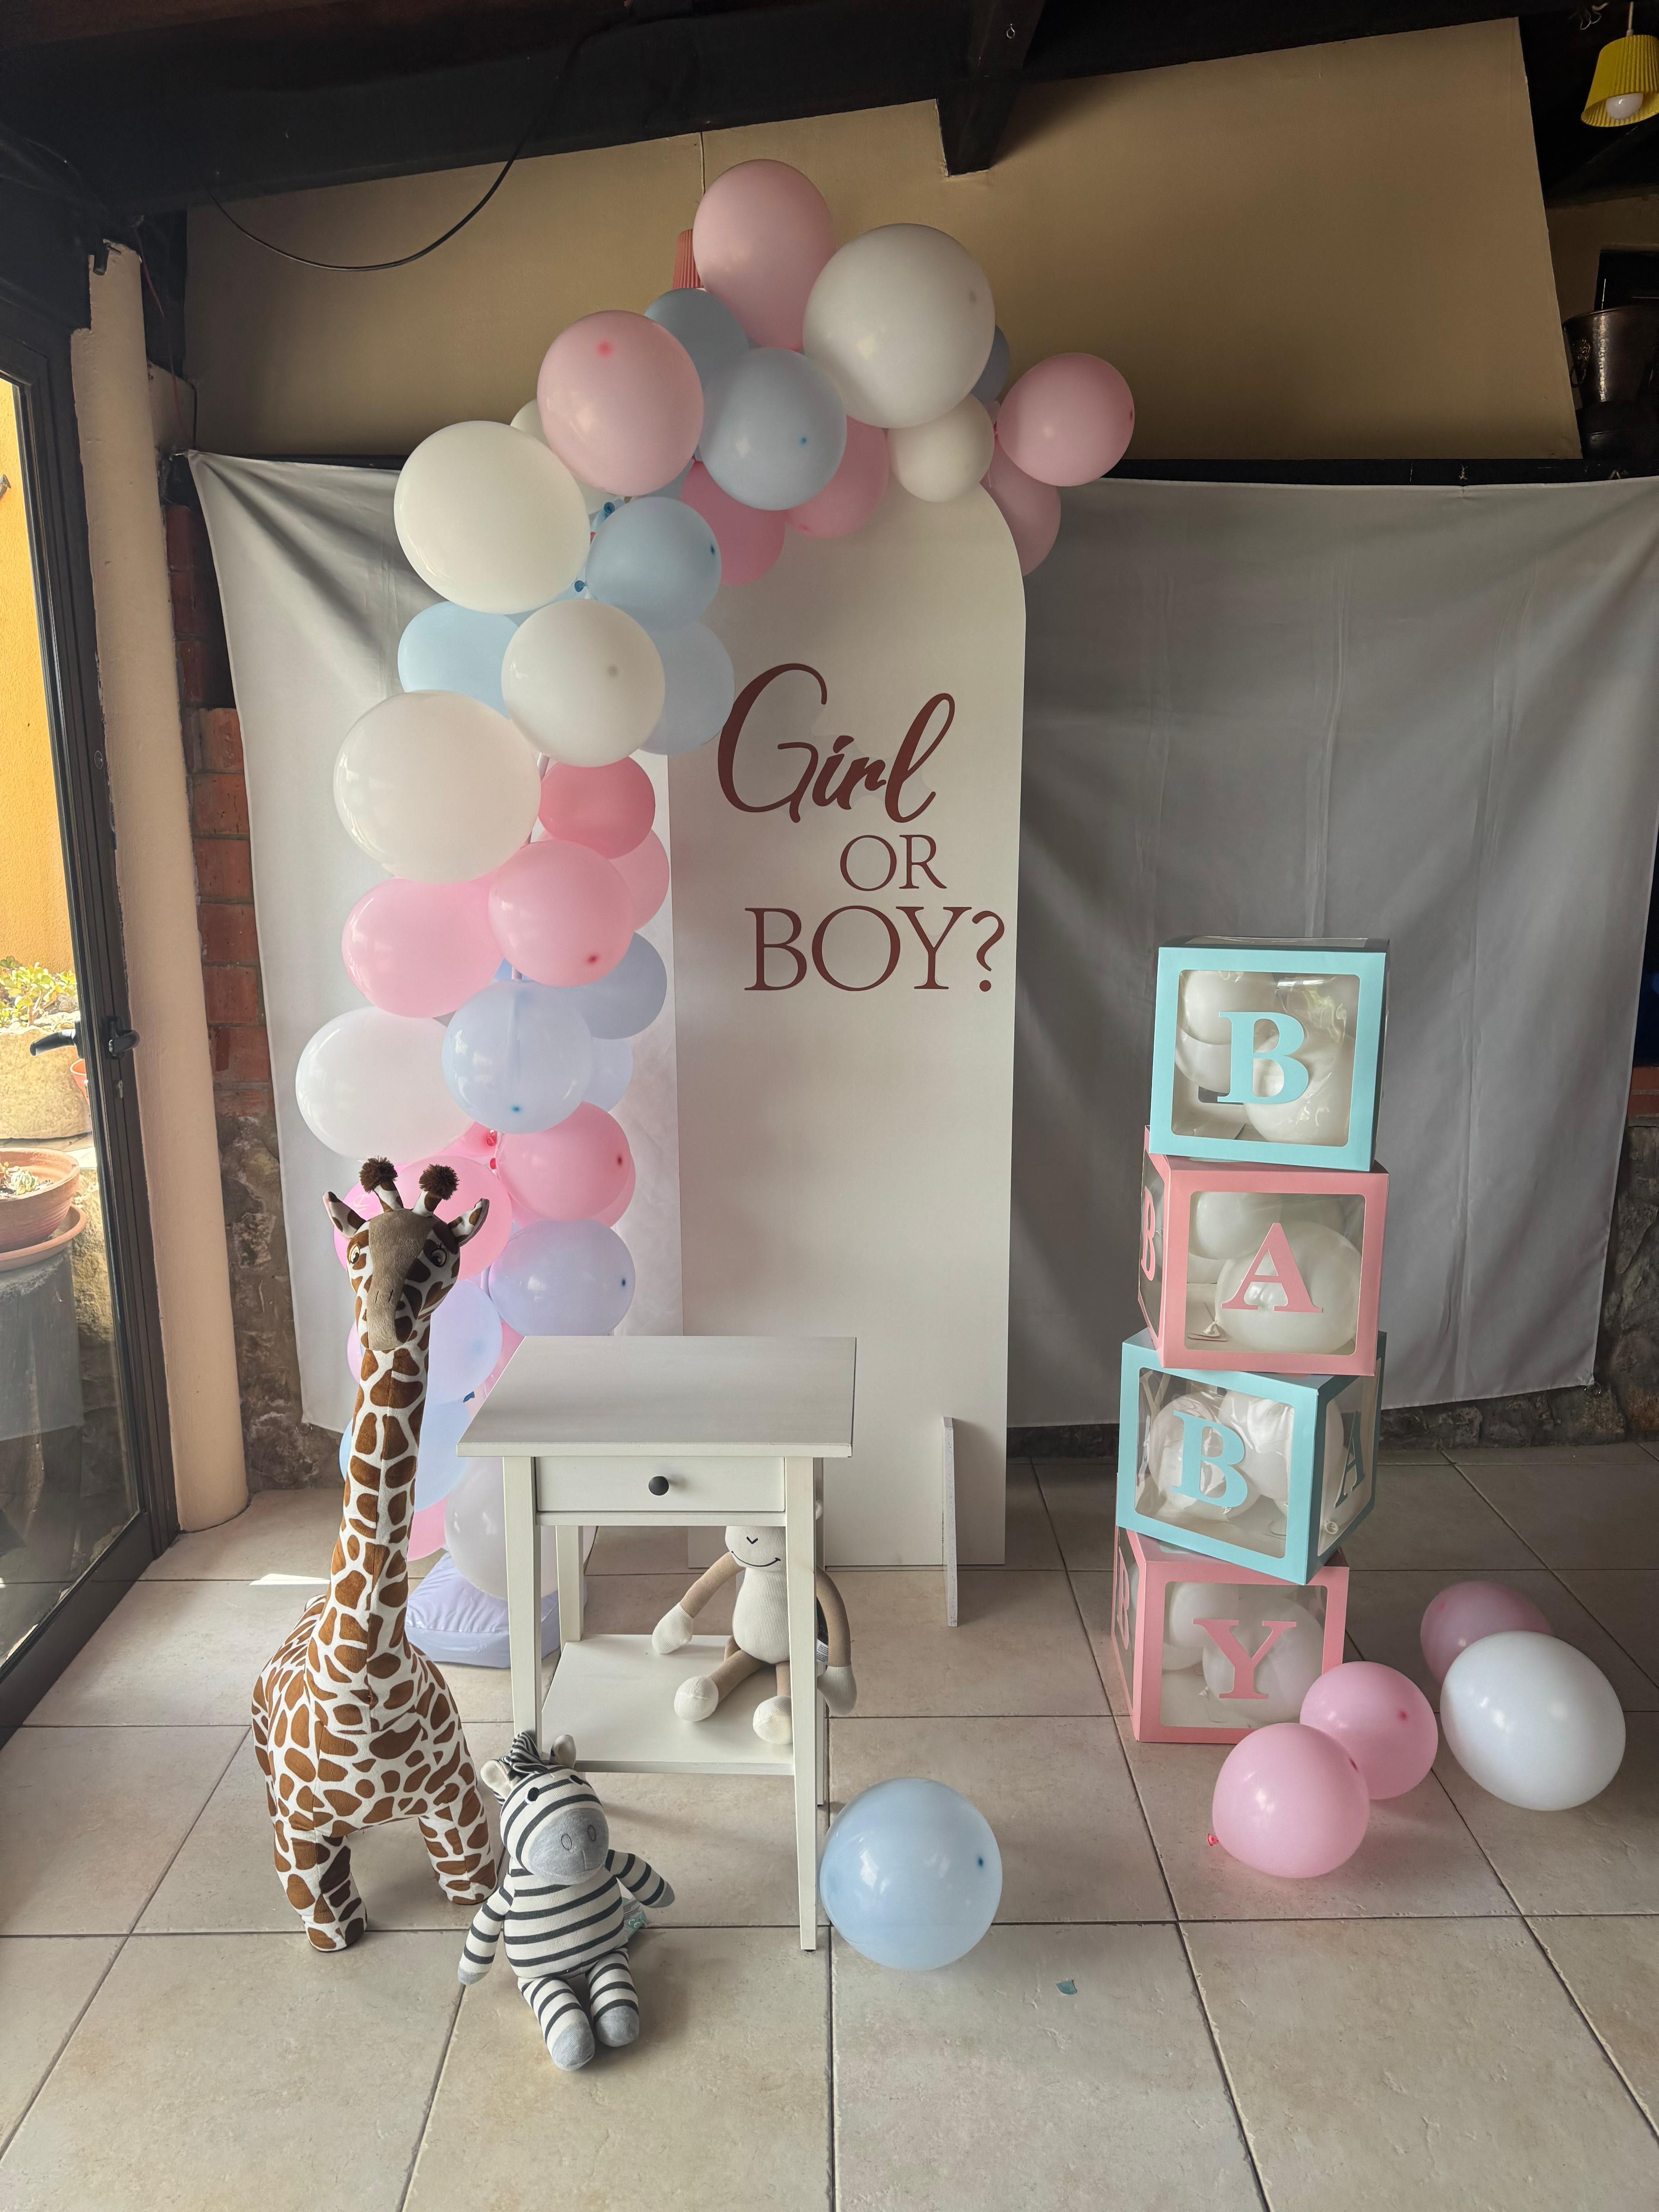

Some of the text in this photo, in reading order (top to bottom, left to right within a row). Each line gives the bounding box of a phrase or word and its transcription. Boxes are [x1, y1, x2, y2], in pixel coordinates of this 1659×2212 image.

[717, 663, 955, 823] Girl
[840, 834, 947, 891] OR
[744, 905, 1005, 992] BOY?
[1217, 1011, 1309, 1104] B
[1141, 1185, 1156, 1281] B
[1221, 1222, 1323, 1313] A
[1169, 1411, 1248, 1508] B
[1333, 1410, 1365, 1508] A
[1117, 1546, 1129, 1650] B
[1193, 1619, 1297, 1699] Y
